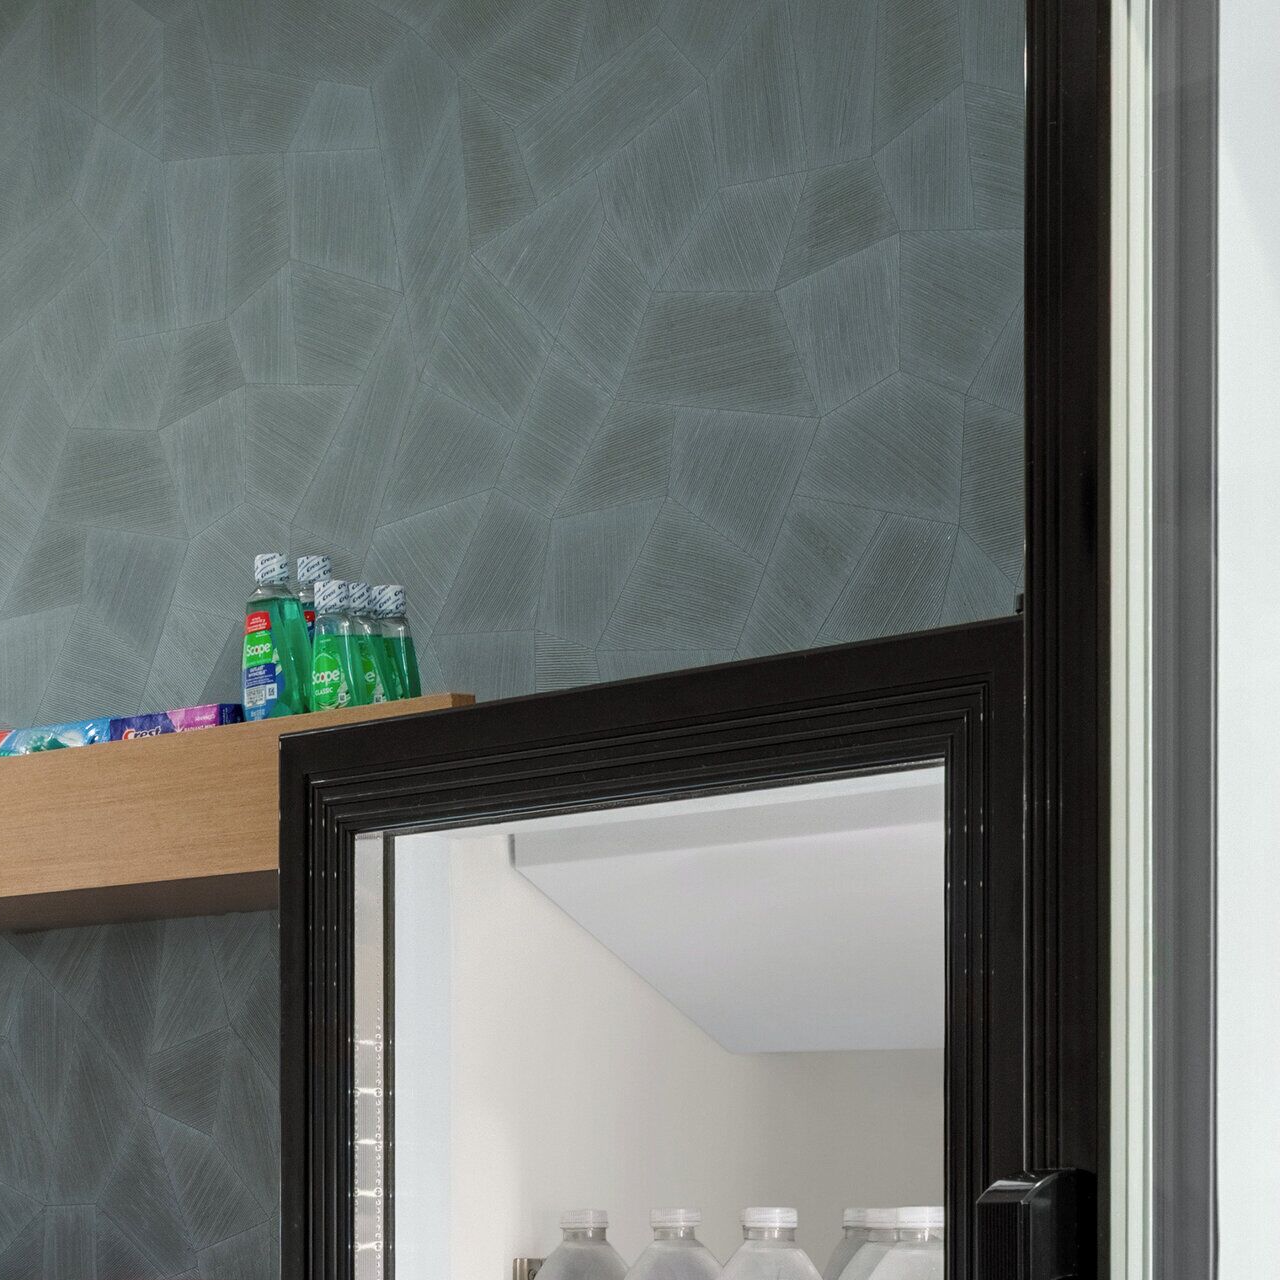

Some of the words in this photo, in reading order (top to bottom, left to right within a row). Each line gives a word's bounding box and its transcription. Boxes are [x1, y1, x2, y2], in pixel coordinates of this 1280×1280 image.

[260, 555, 276, 565] Crest
[261, 567, 275, 578] Crest
[246, 643, 271, 657] Scope
[312, 669, 340, 686] Scope
[314, 687, 333, 696] CLASSIC
[122, 726, 162, 740] Crest
